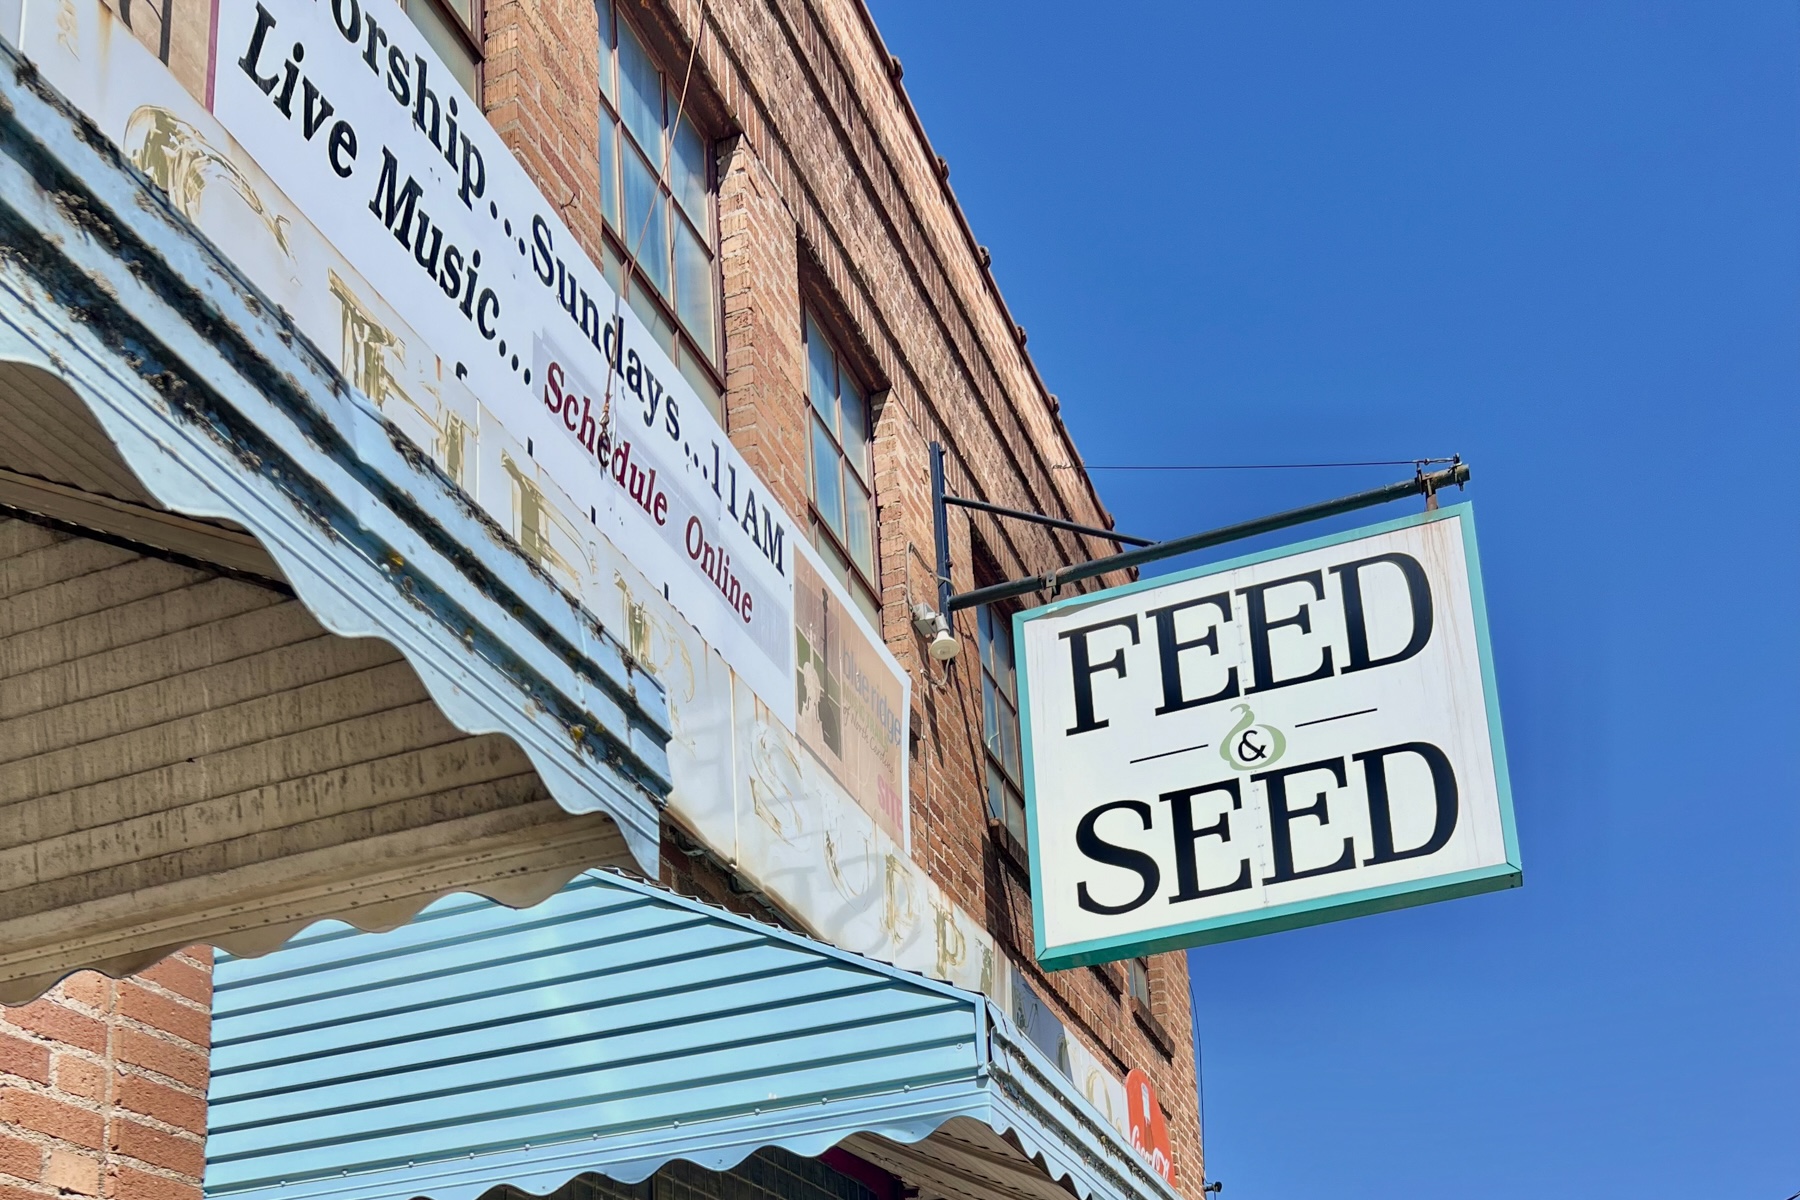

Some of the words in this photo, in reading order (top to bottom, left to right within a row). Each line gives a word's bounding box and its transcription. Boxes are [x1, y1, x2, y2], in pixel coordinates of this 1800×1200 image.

[238, 0, 358, 179] Live
[544, 361, 668, 526] Schedule
[685, 515, 753, 624] Online
[842, 640, 870, 703] blue
[871, 684, 902, 746] ridge
[1057, 551, 1435, 736] FEED
[1074, 740, 1460, 917] SEED
[1235, 728, 1268, 764] &
